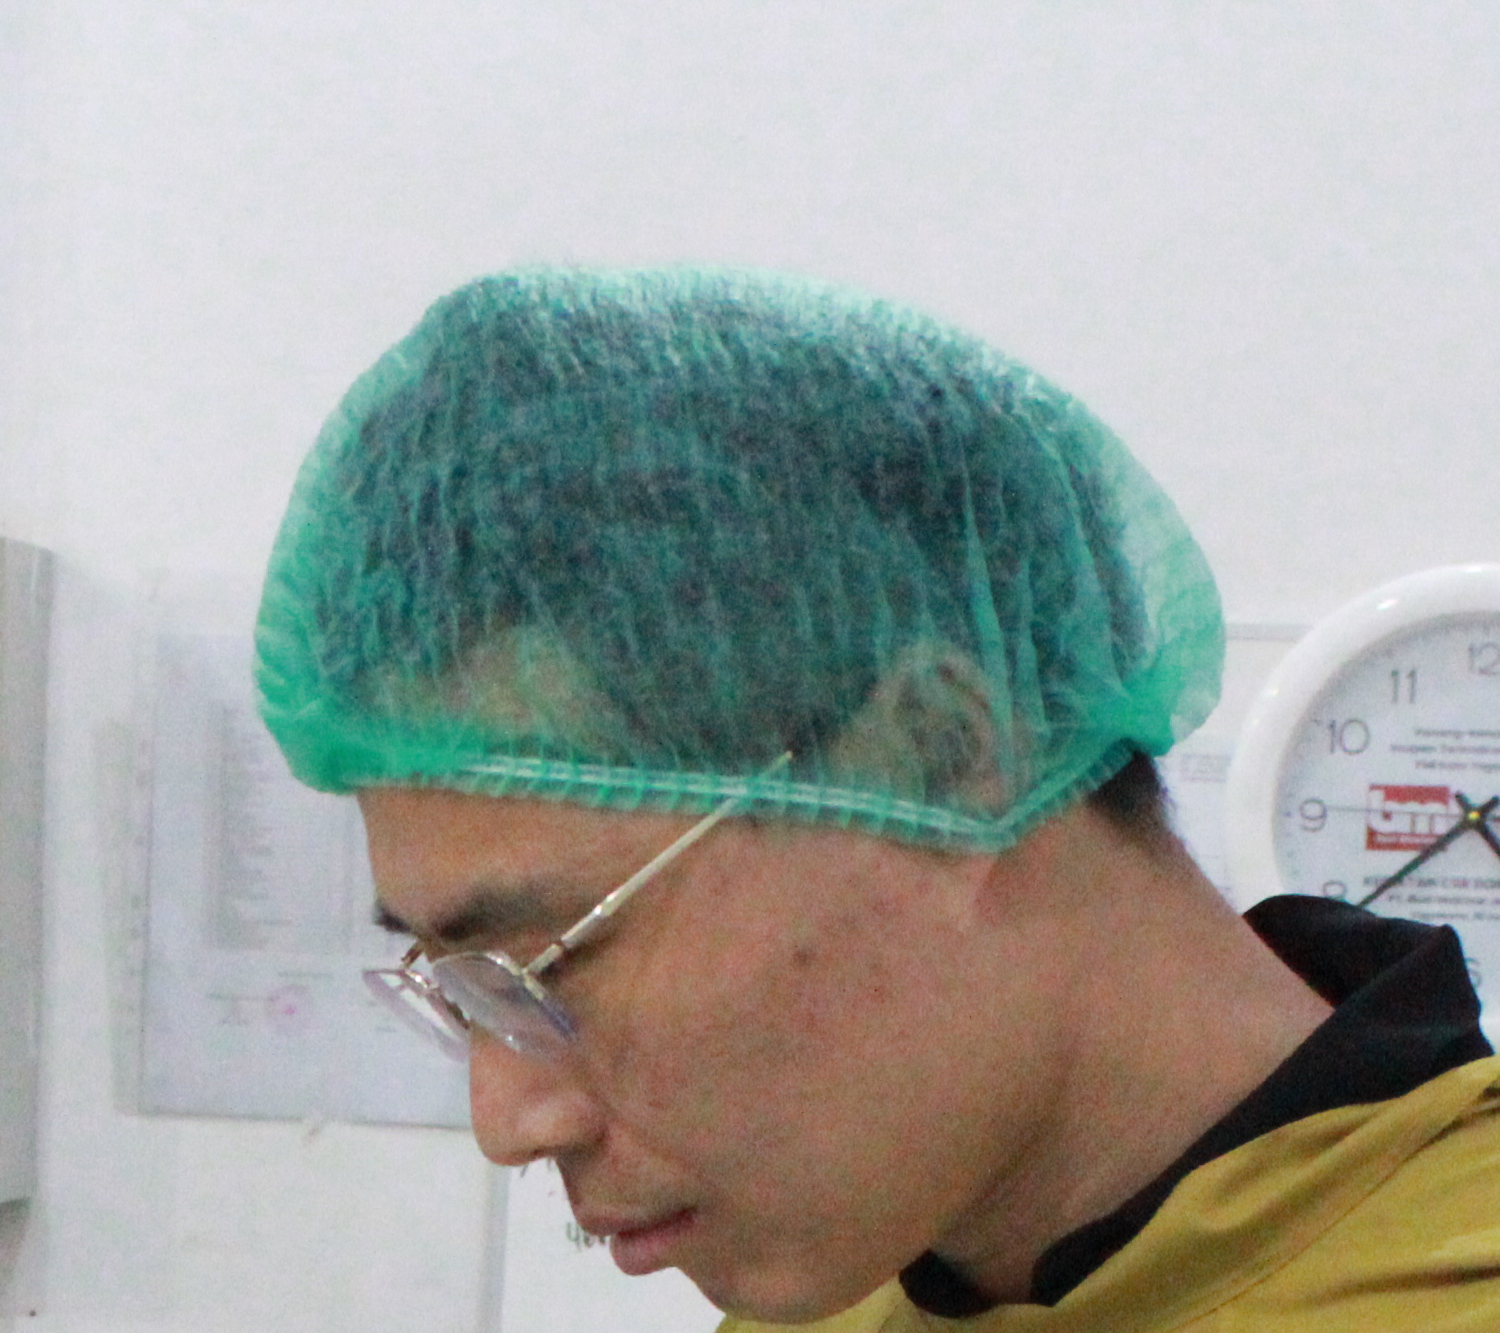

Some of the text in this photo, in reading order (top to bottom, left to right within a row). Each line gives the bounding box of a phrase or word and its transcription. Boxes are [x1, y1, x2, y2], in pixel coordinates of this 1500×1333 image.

[1391, 669, 1418, 704] 11
[1326, 719, 1370, 755] 10
[1300, 799, 1327, 832] 9
